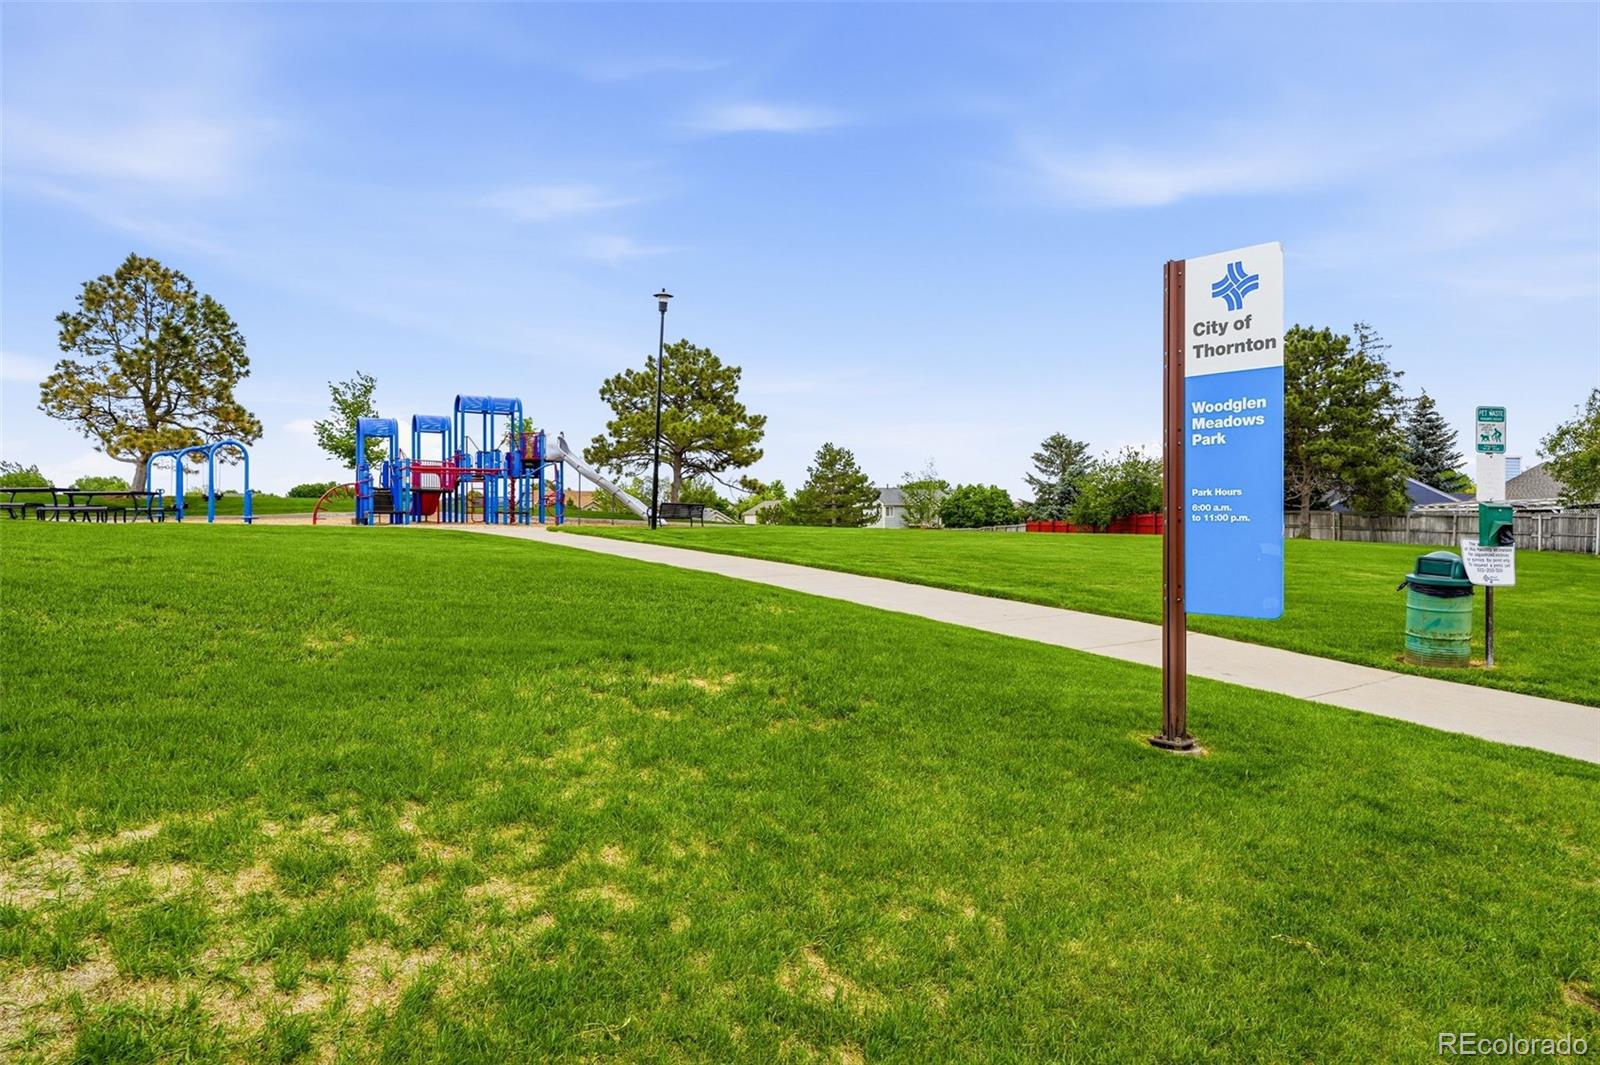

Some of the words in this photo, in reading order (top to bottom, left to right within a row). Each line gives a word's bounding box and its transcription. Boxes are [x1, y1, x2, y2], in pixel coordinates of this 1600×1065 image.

[1193, 320, 1229, 337] City
[1233, 314, 1252, 331] of
[1193, 337, 1277, 359] Thornton
[1191, 397, 1267, 414] Woodglen
[1191, 414, 1265, 430] Meadows
[1191, 432, 1226, 446] Park
[1191, 488, 1212, 497] Park
[1214, 488, 1243, 496] Hours
[1191, 504, 1212, 512] 6:00
[1191, 514, 1201, 522] to
[1204, 514, 1229, 522] 11:00
[1230, 515, 1251, 523] p.m.
